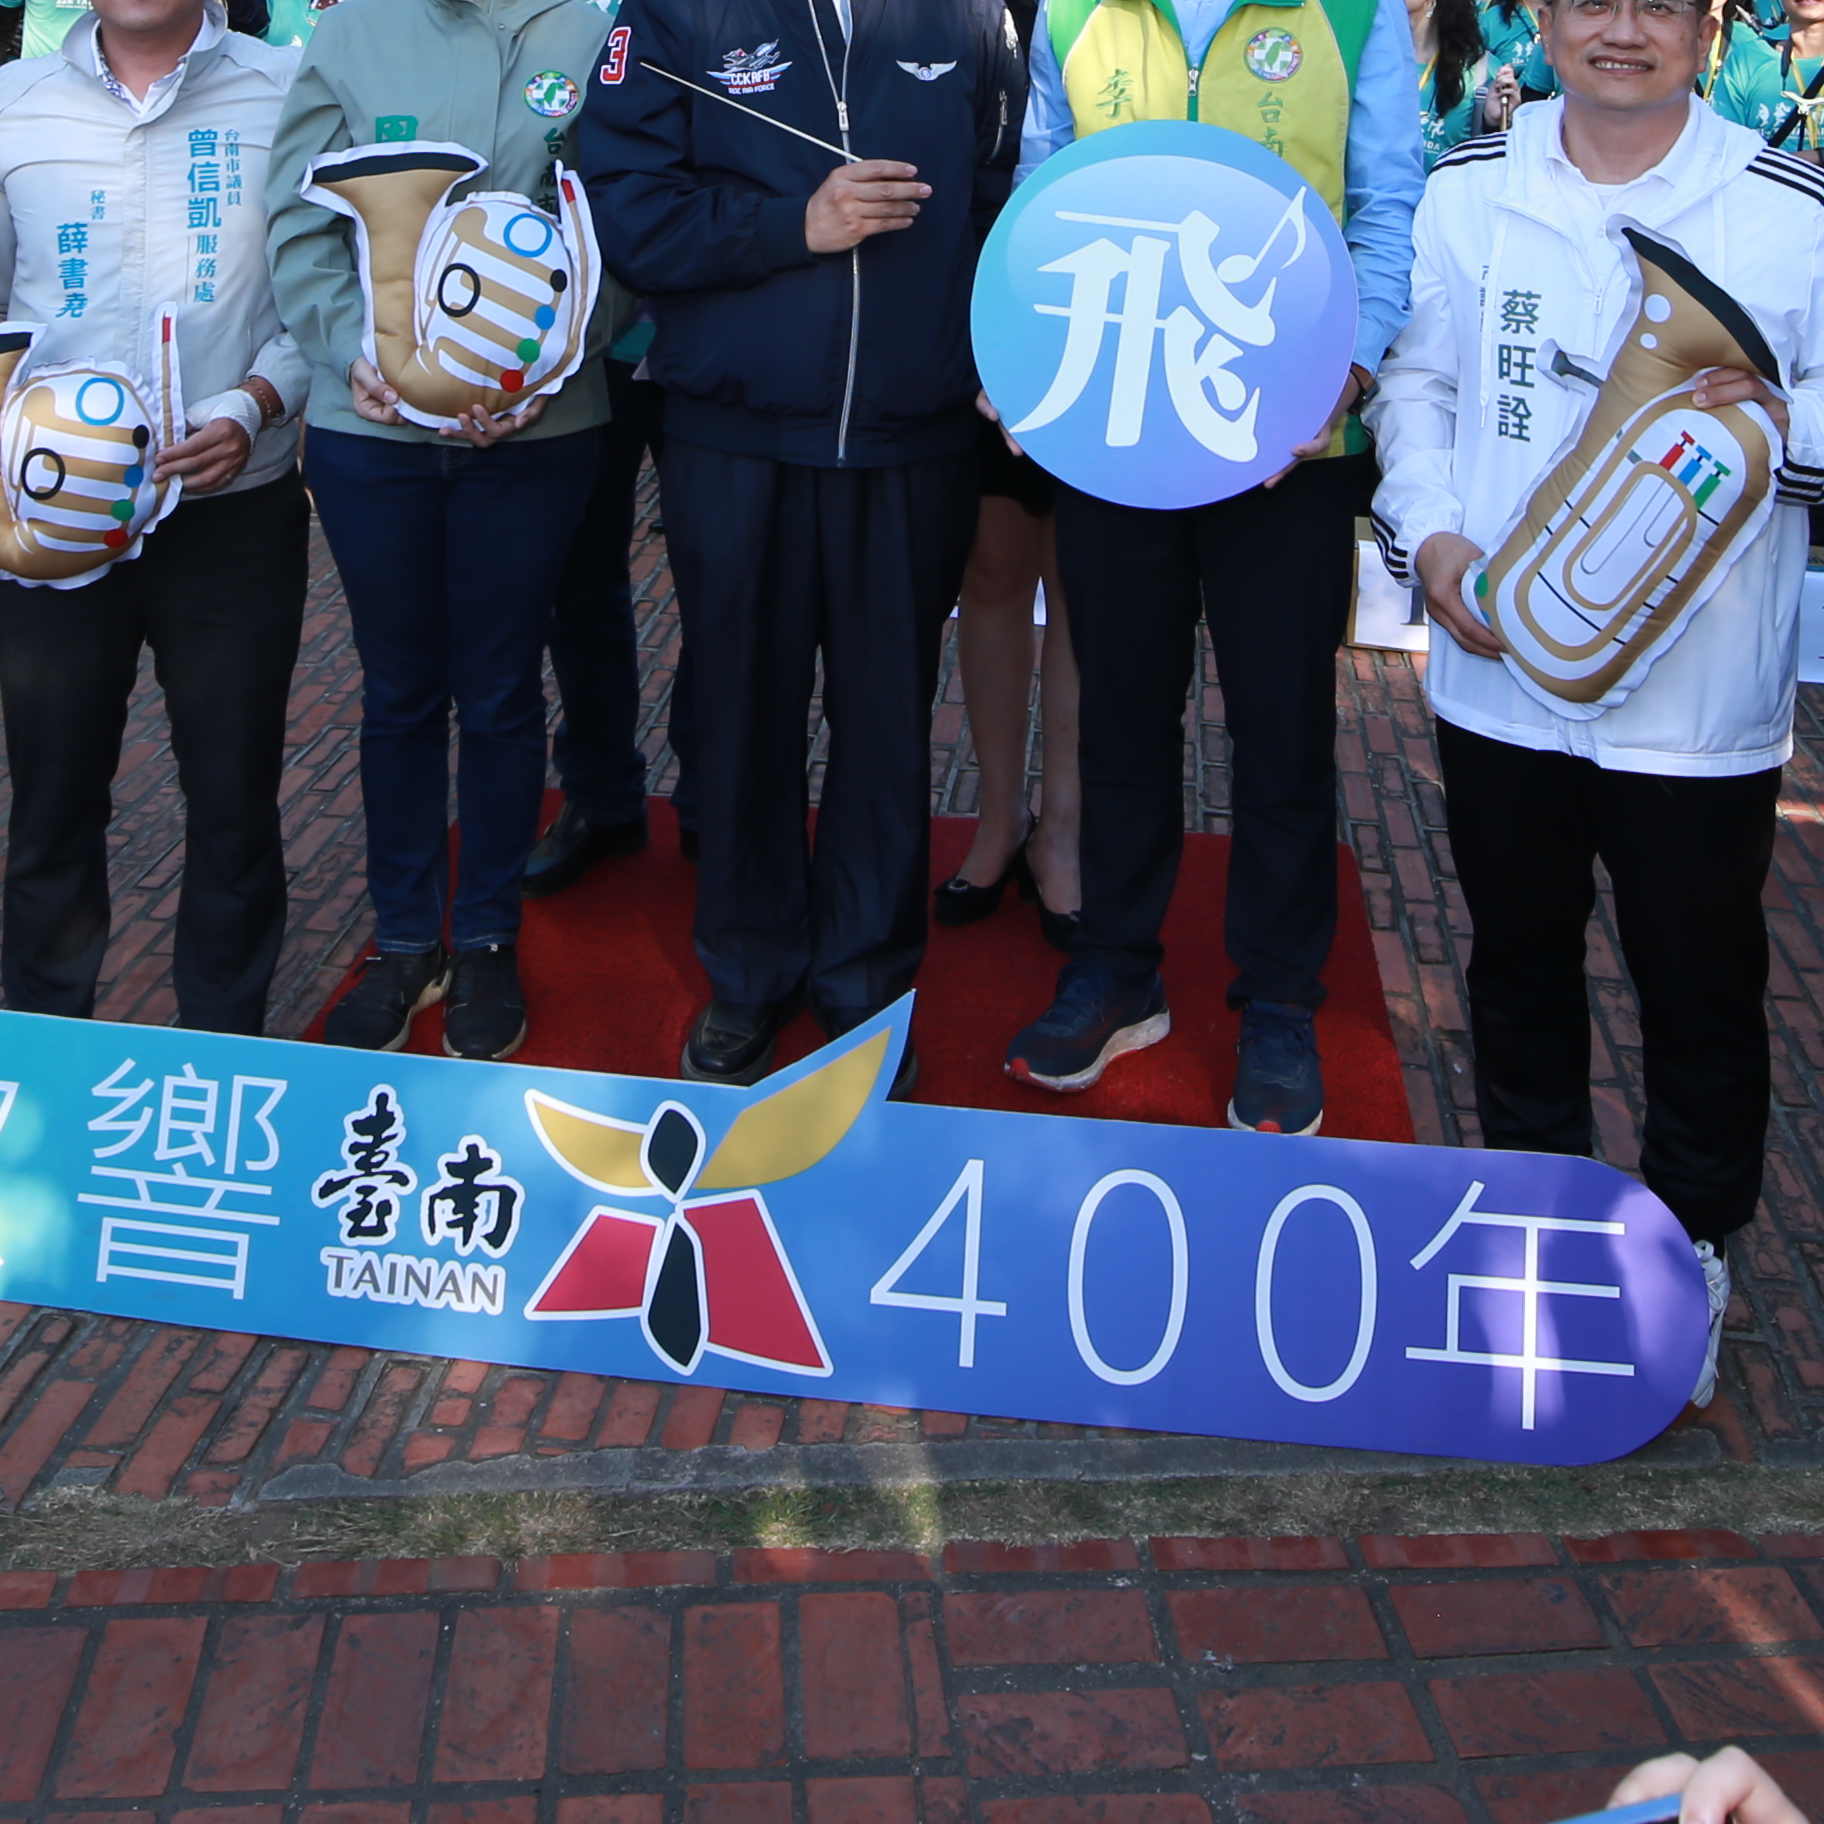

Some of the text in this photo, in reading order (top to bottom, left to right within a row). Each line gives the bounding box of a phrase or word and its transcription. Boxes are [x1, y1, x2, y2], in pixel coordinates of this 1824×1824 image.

[600, 26, 632, 85] 3
[1096, 68, 1134, 119] 李
[90, 189, 106, 220] 秘書
[187, 129, 222, 229] 曾信凱
[224, 129, 243, 207] 台南市議員
[193, 234, 219, 303] 服務處
[1008, 185, 1307, 463] 飛
[1497, 288, 1542, 443] 蔡旺詮
[314, 1088, 522, 1252] 臺南
[869, 1157, 1634, 1431] 400年
[326, 1252, 500, 1308] TAINAN
